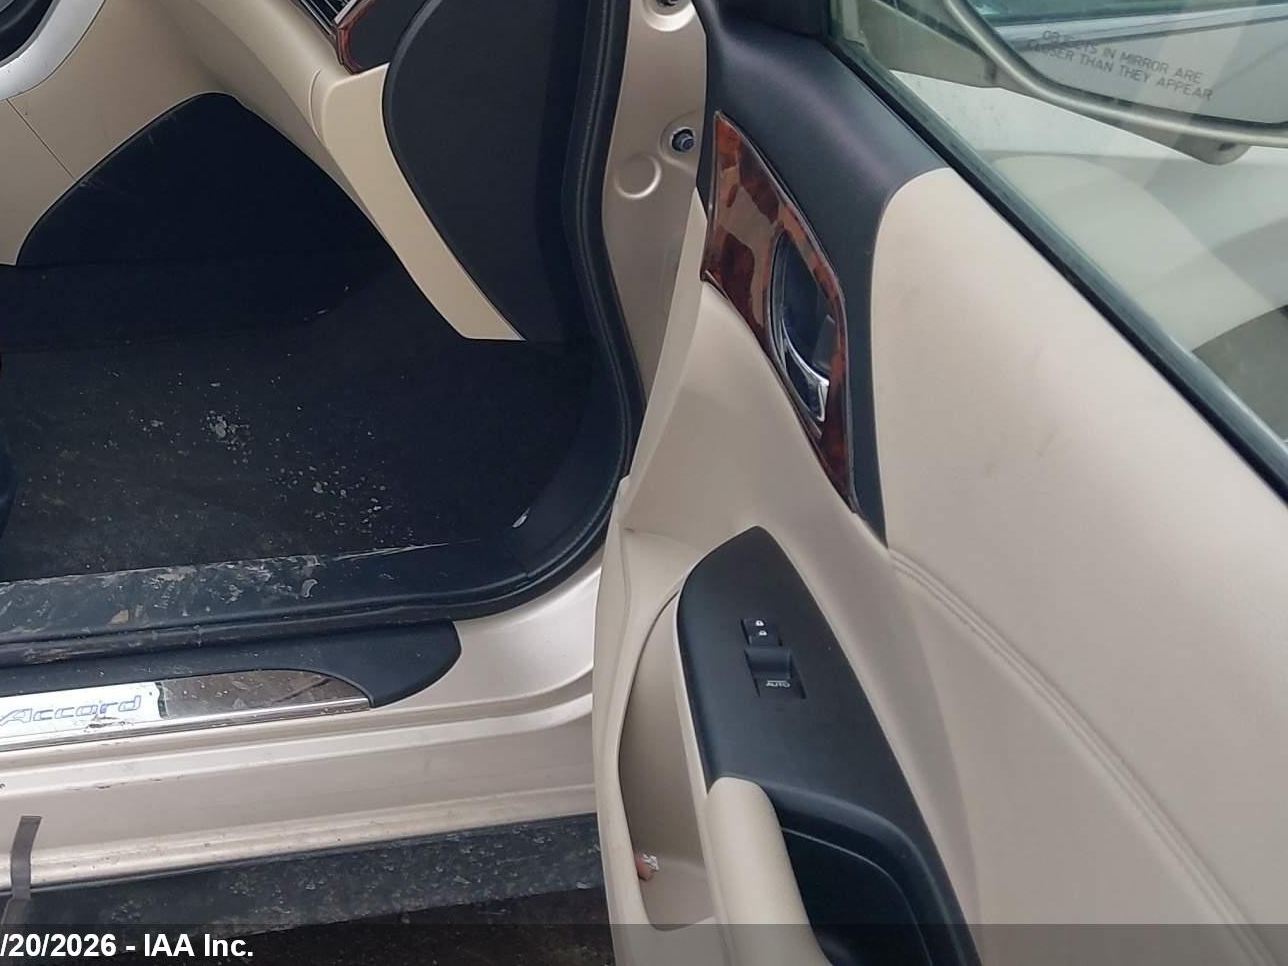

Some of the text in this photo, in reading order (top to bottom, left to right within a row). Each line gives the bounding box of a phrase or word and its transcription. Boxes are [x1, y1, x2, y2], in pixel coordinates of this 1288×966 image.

[1079, 54, 1114, 73] THAN
[1119, 64, 1153, 84] THEY
[1155, 76, 1214, 102] APPEAR
[1102, 47, 1115, 59] IN
[1119, 51, 1169, 74] MIRROR
[1174, 67, 1204, 84] ARE
[765, 680, 791, 689] AUTO
